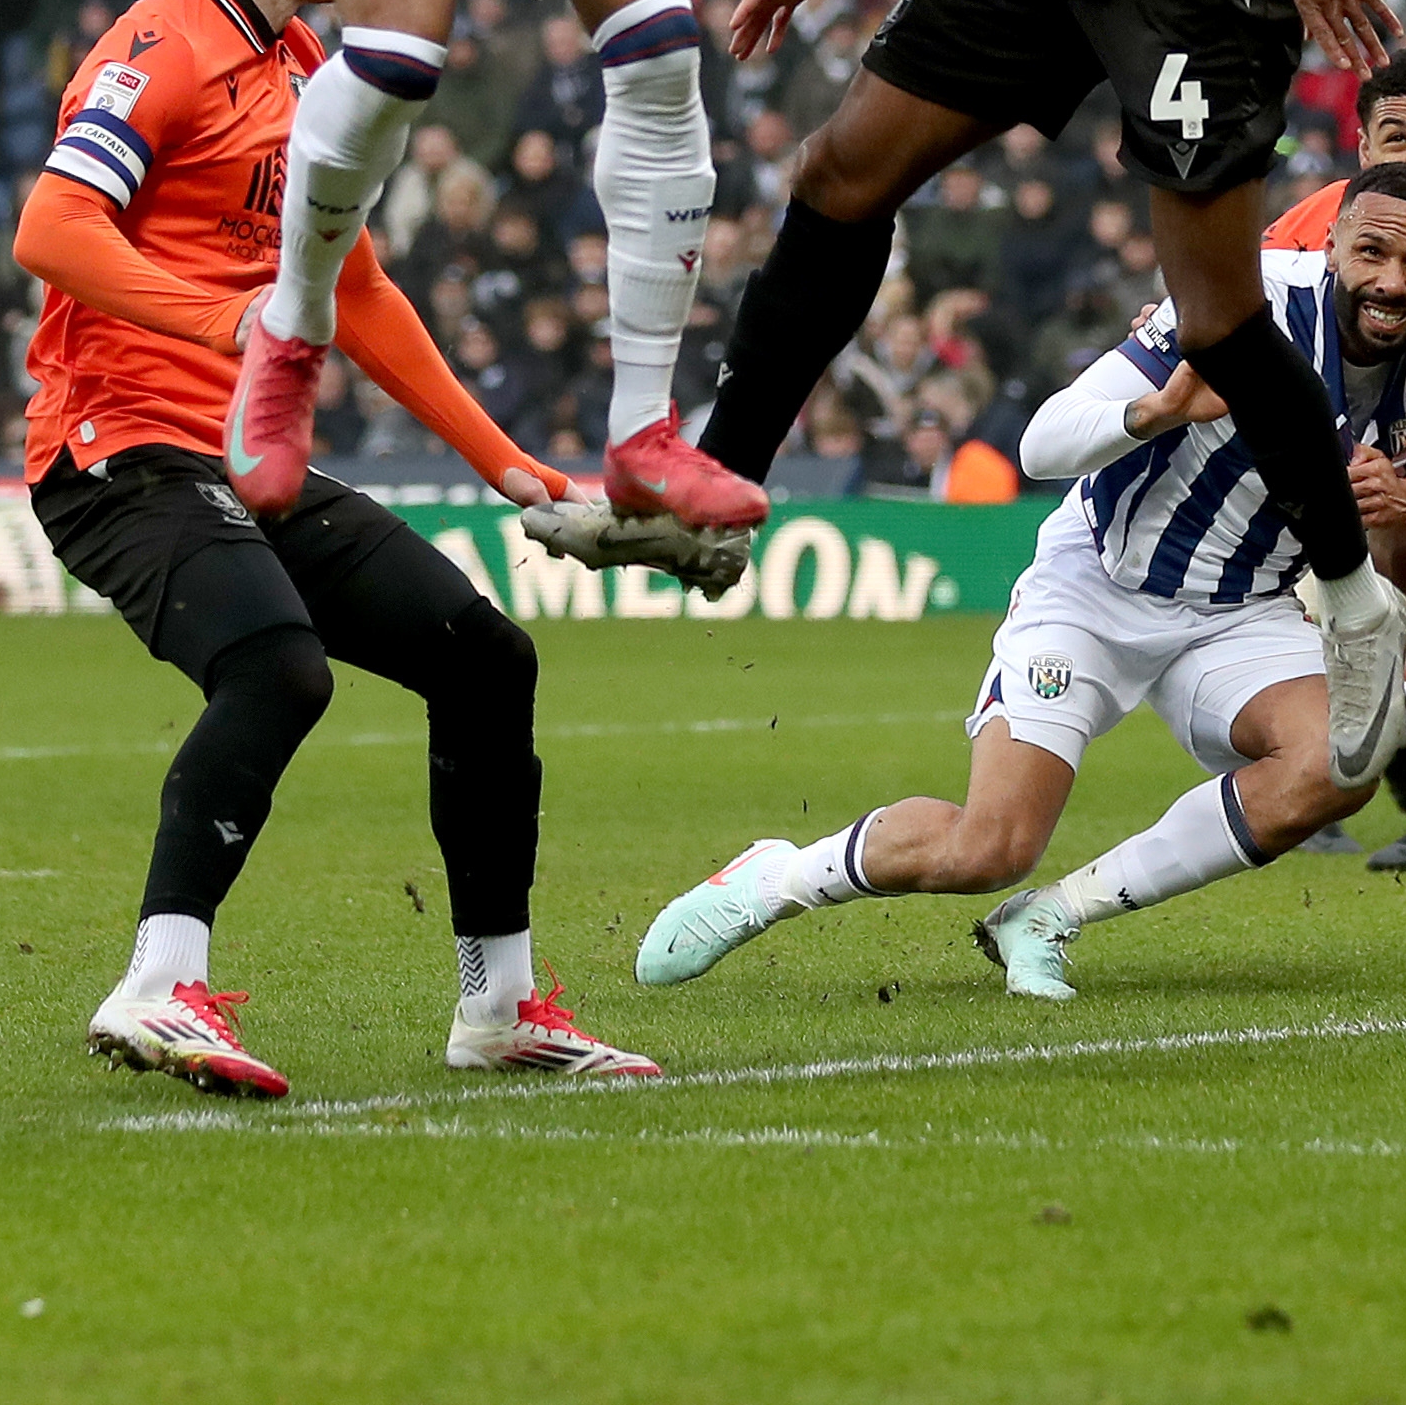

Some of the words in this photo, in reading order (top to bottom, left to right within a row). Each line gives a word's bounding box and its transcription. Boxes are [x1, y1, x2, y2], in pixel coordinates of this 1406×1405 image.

[118, 72, 139, 88] bet
[1150, 53, 1209, 140] 4
[84, 127, 128, 159] CAPTAIN
[1032, 657, 1070, 669] ALBION
